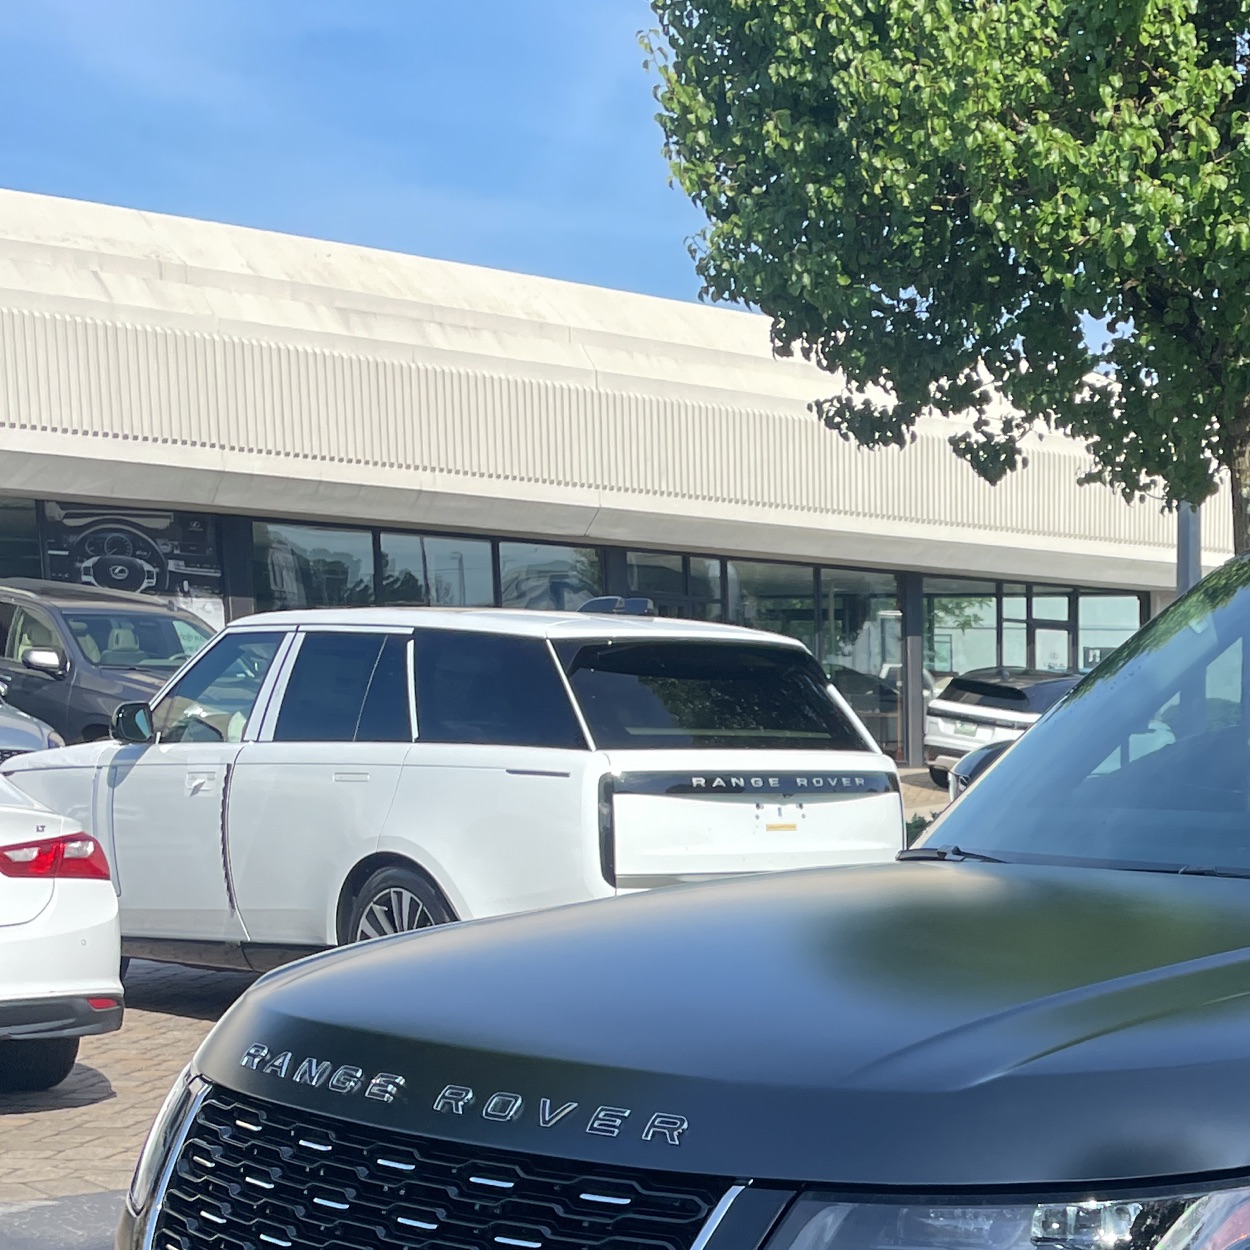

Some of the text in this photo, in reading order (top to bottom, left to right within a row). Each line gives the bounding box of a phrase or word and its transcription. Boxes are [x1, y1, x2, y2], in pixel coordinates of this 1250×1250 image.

[691, 776, 866, 788] RANGE ROVER
[35, 824, 46, 833] LT
[239, 1042, 690, 1146] RANGE ROVER
